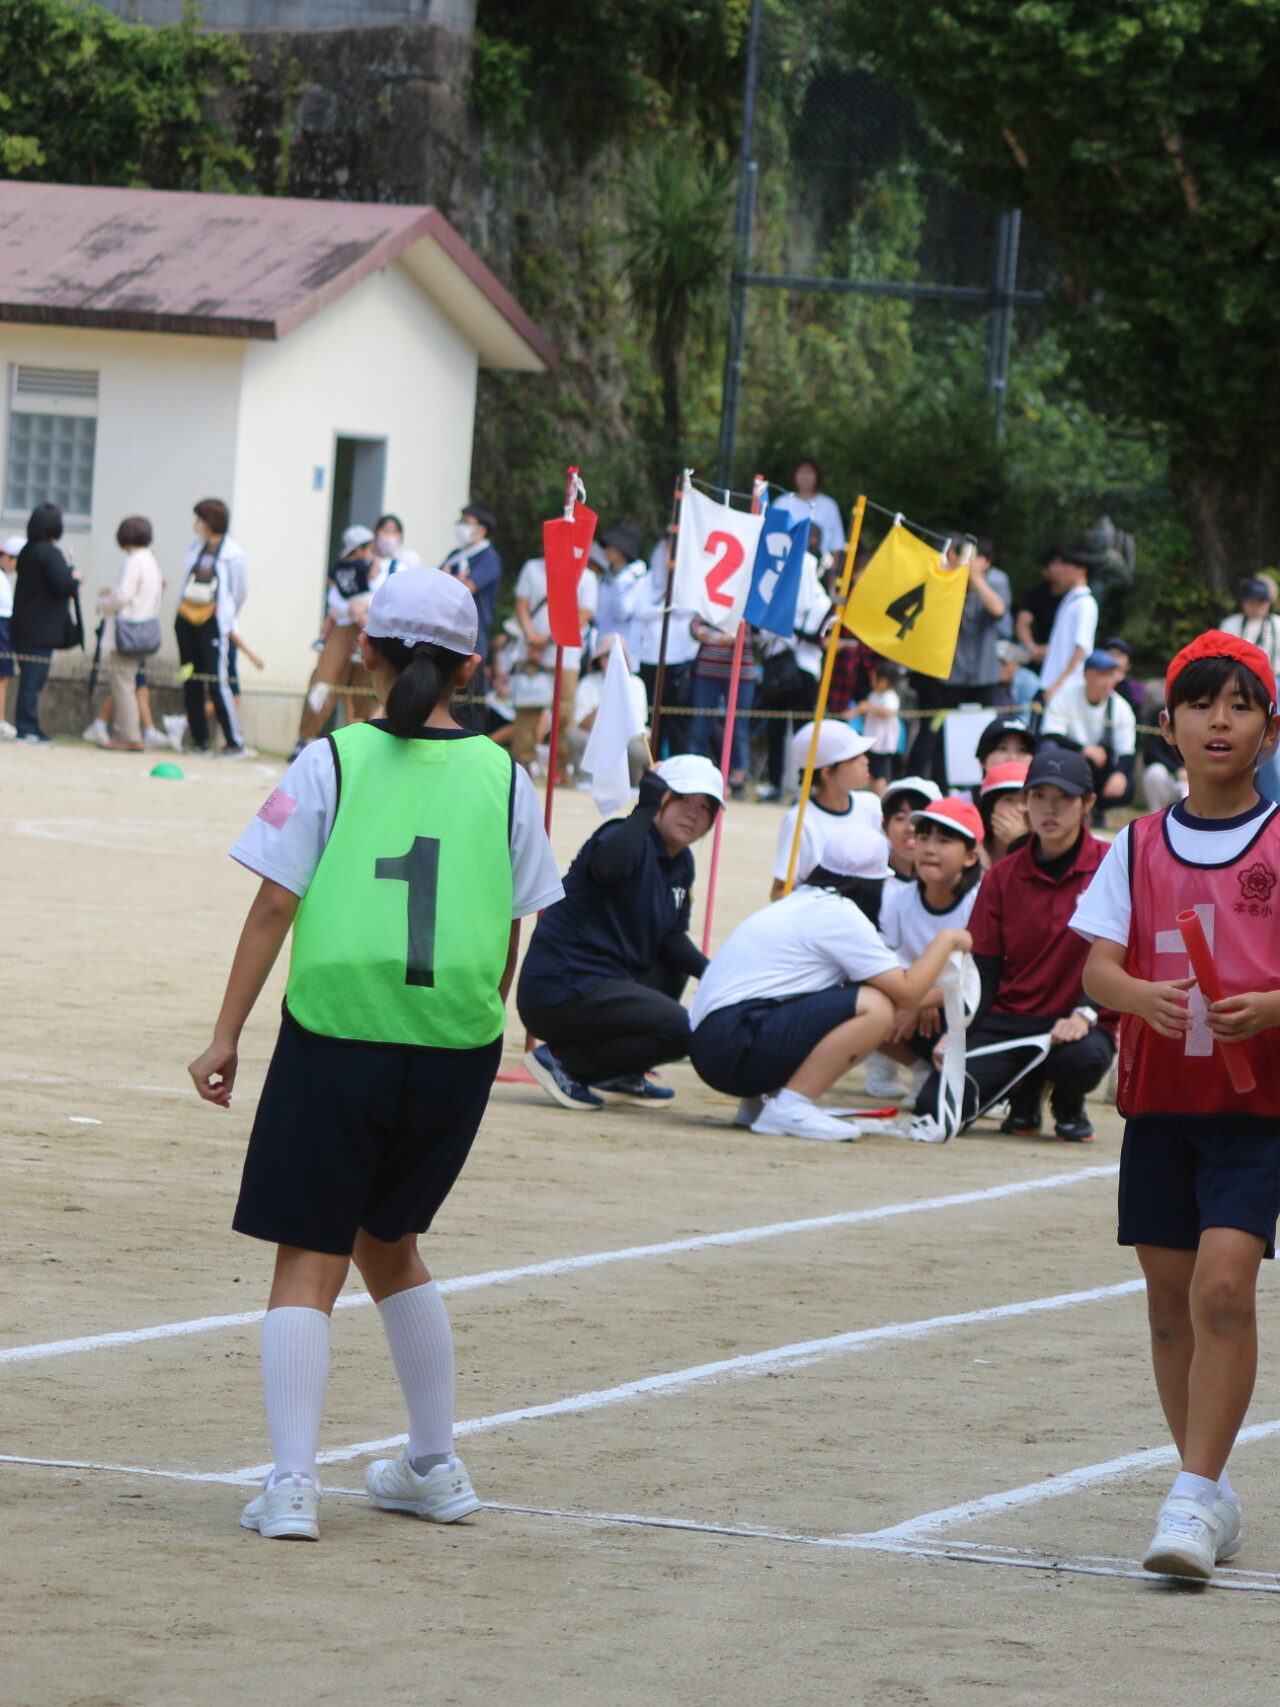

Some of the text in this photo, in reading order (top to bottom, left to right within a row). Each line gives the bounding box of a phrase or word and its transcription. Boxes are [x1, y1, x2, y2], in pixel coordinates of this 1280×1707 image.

[704, 530, 746, 608] 2
[885, 582, 926, 641] 4
[374, 836, 441, 988] 1
[1233, 902, 1273, 918] 本名小
[1155, 903, 1216, 1057] 1
